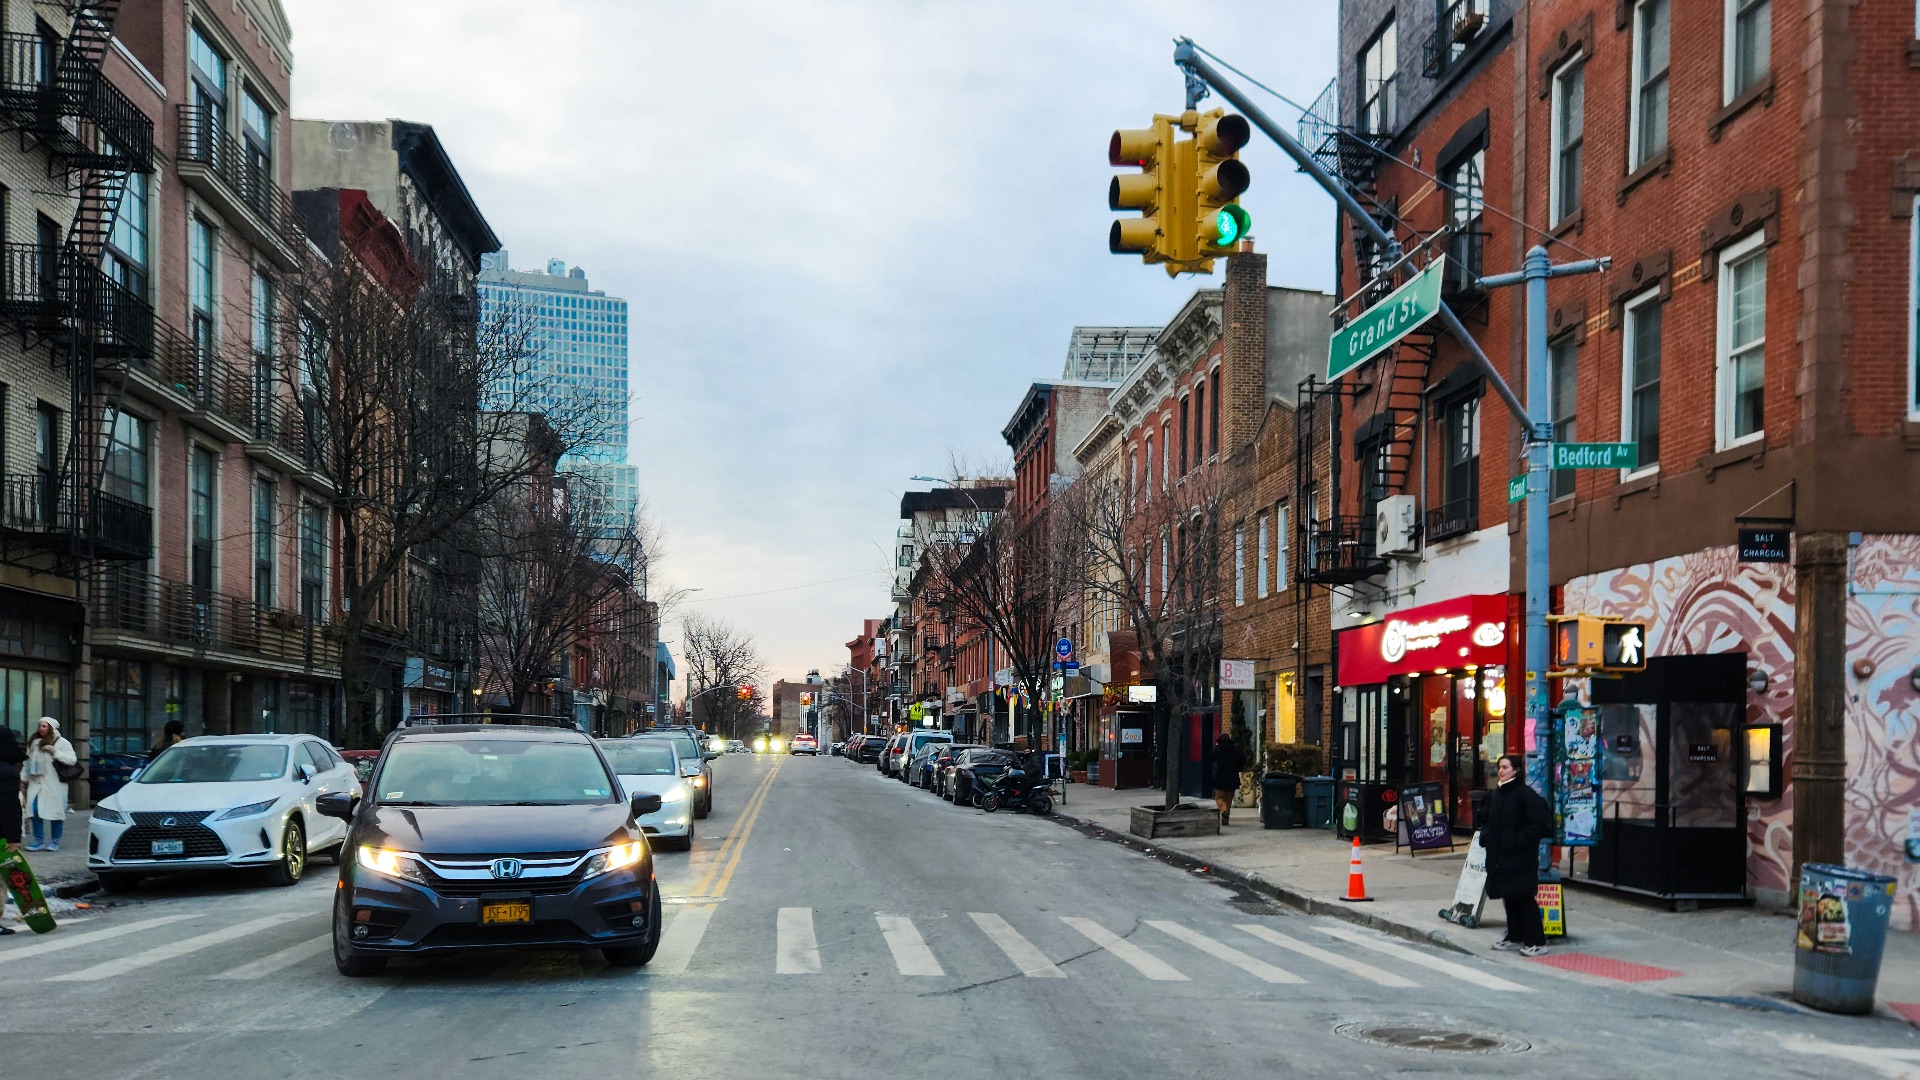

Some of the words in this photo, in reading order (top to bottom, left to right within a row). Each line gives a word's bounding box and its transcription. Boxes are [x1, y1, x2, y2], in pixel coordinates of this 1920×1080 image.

[1349, 305, 1397, 356] Grand
[1399, 290, 1419, 323] St
[1558, 446, 1611, 466] Bedford
[1616, 446, 1628, 457] Av
[1510, 477, 1526, 500] Grand
[1755, 533, 1774, 542] SALT
[1743, 549, 1785, 558] CHARCOAL
